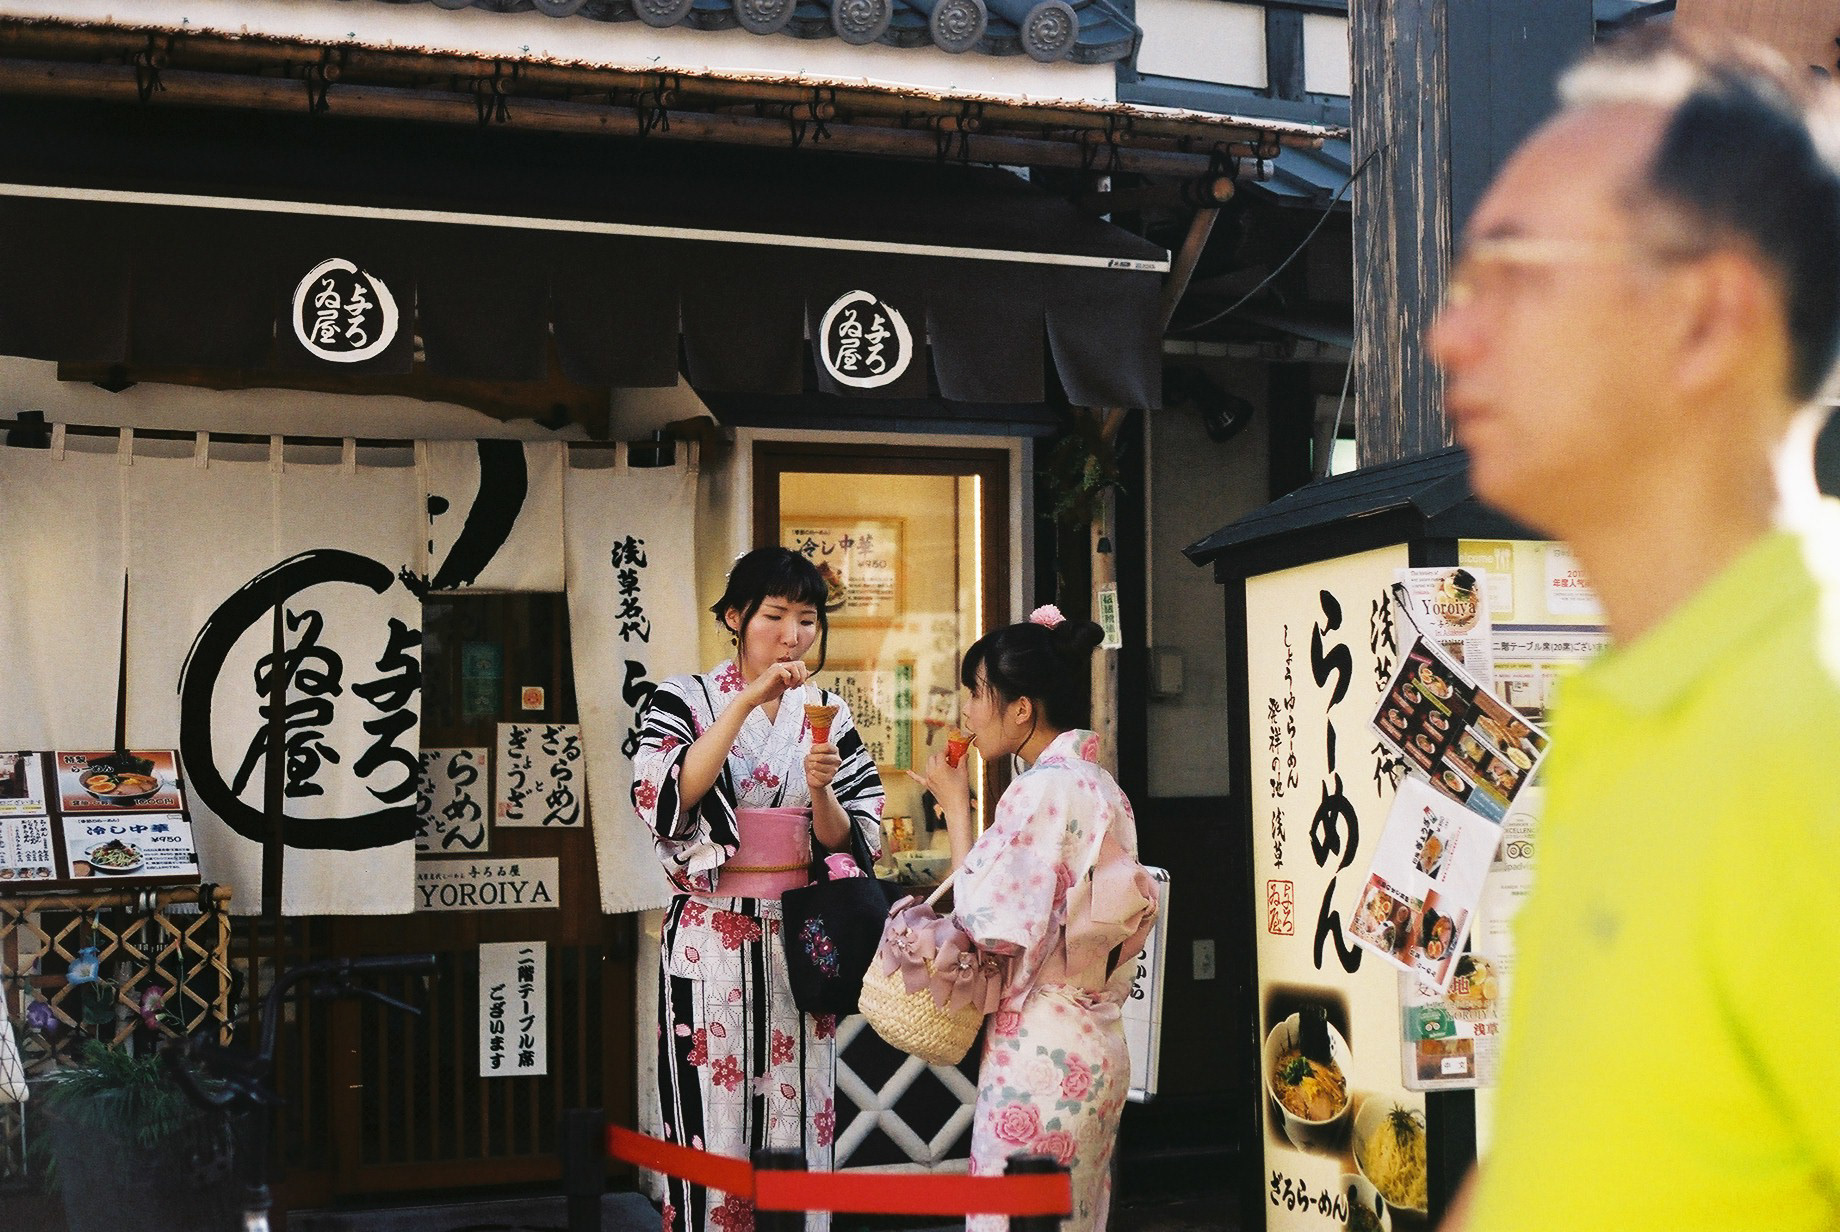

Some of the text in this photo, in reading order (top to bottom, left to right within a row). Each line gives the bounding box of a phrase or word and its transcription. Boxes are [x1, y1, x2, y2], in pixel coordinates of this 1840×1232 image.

[611, 535, 651, 643] 浅草名代
[1421, 599, 1477, 617] Yoroiya
[1283, 624, 1299, 788] しょうゆらーめん
[442, 749, 486, 850] らーめん
[506, 725, 533, 820] ぎょうざ
[541, 725, 582, 826] ざるらーめん
[1267, 698, 1286, 870] 発祥の地 浅草
[1309, 590, 1363, 974] らーめん
[87, 823, 169, 836] 冷し中華
[417, 880, 552, 908] YOROIYA
[489, 983, 506, 1070] ございます
[517, 948, 535, 1068] 二階テーブル席
[1269, 1169, 1348, 1223] ざるらーめん
